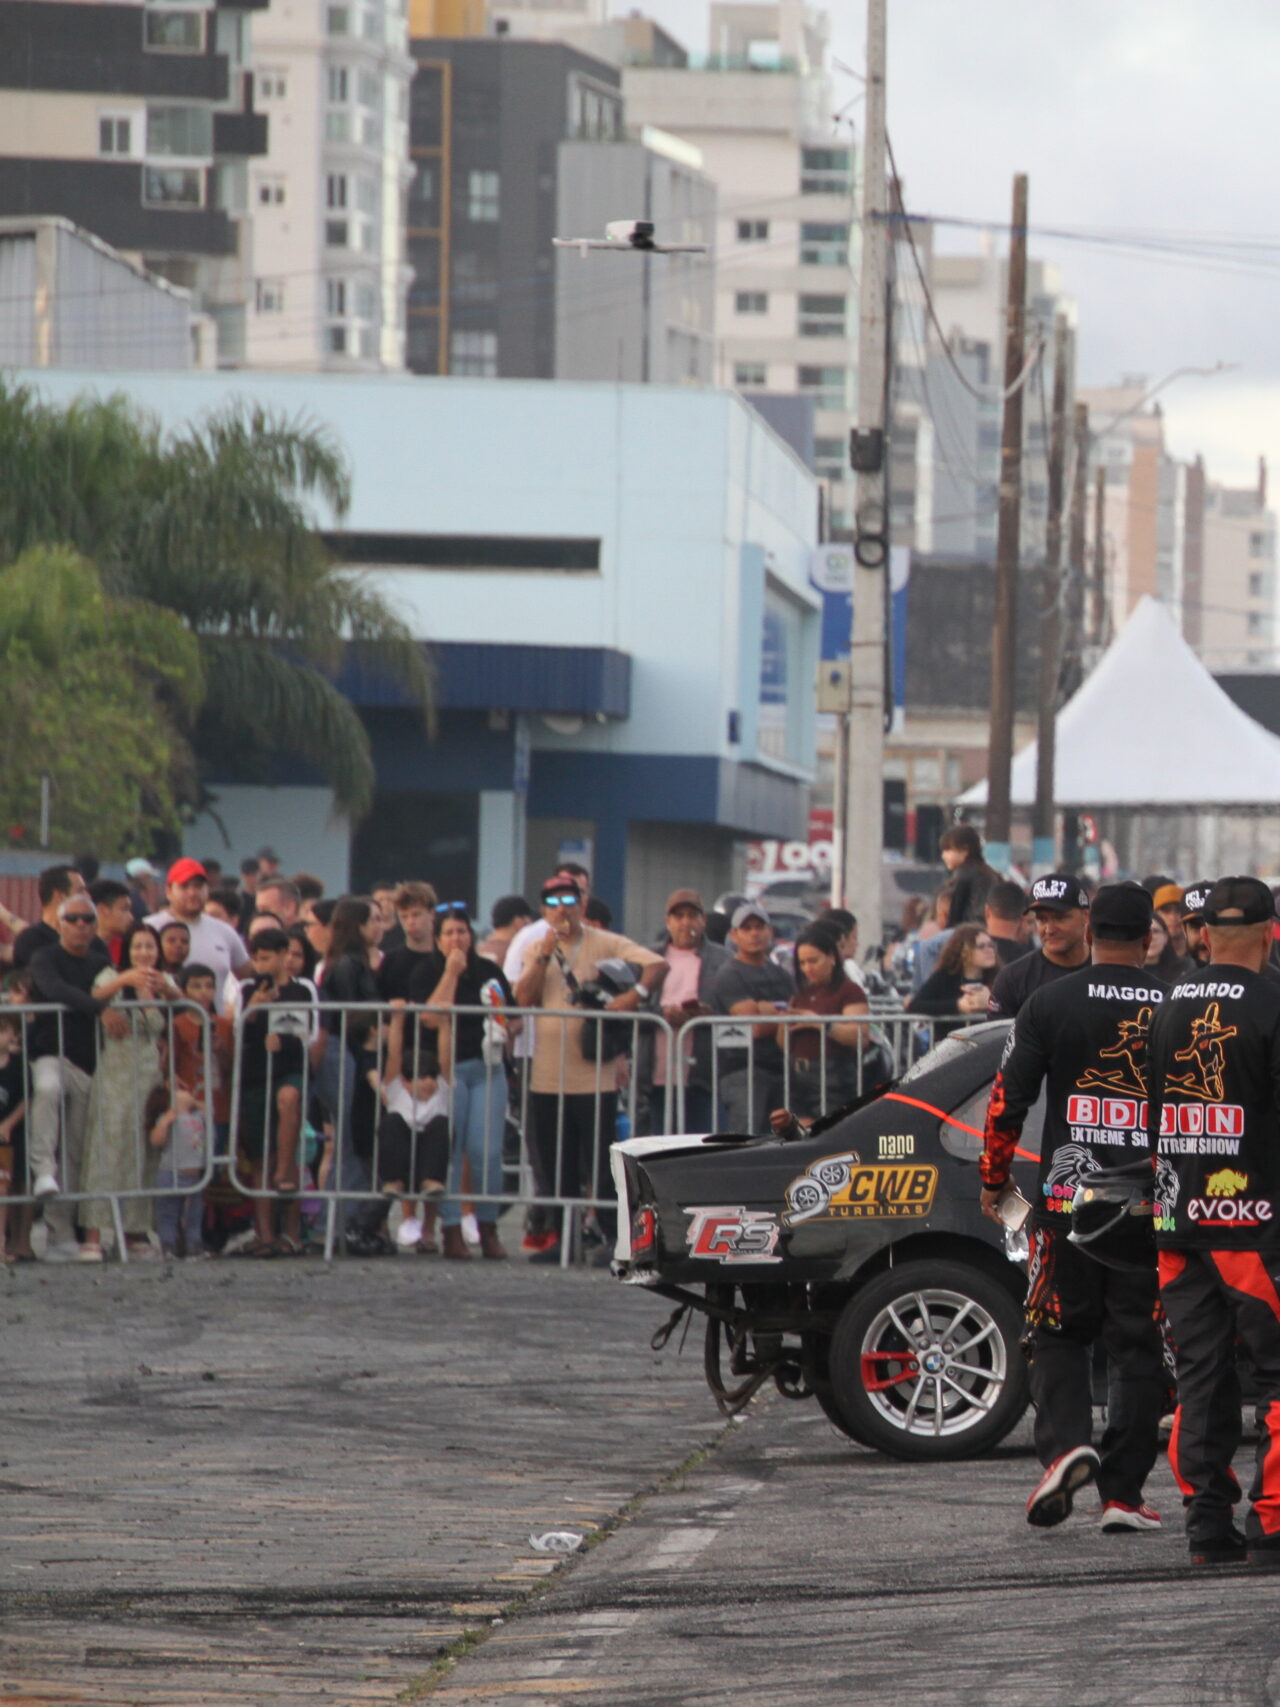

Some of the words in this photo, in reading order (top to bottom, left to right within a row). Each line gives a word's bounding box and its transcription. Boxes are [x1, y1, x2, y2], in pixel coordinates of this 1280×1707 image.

[1088, 983, 1163, 1003] MAGOO
[1170, 982, 1245, 1001] RICARDO
[879, 1135, 914, 1154] nano
[1070, 1126, 1126, 1147] EXTREME
[1131, 1131, 1149, 1147] SH
[1198, 1138, 1240, 1155] SHOW
[849, 1170, 933, 1201] CWB
[828, 1205, 924, 1216] TURBINAS
